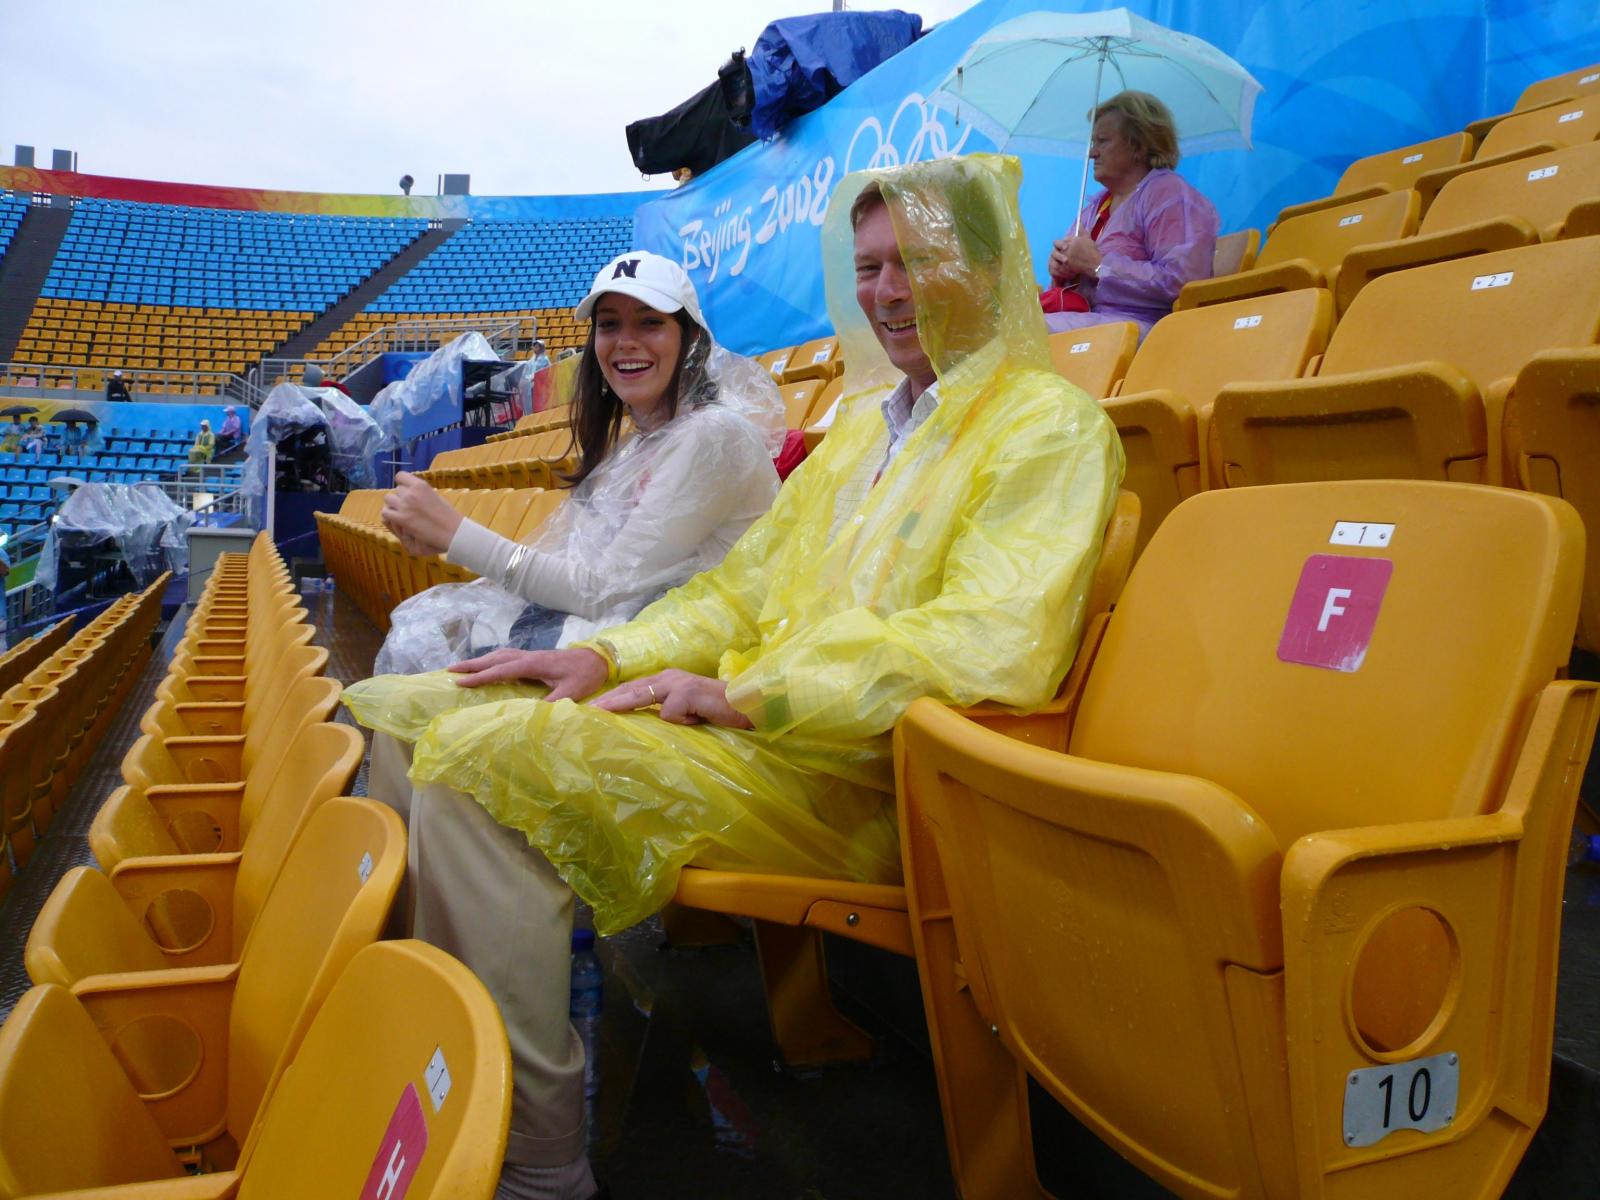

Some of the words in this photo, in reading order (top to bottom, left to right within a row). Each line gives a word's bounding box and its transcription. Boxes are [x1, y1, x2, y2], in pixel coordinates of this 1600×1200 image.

[679, 198, 752, 284] Beijing
[755, 156, 834, 244] 2008
[611, 259, 641, 280] N
[1487, 275, 1497, 287] 2
[1358, 525, 1368, 545] 1
[1317, 587, 1352, 632] F
[431, 1068, 445, 1093] 1
[1379, 1067, 1431, 1129] 10
[376, 1139, 406, 1200] H
